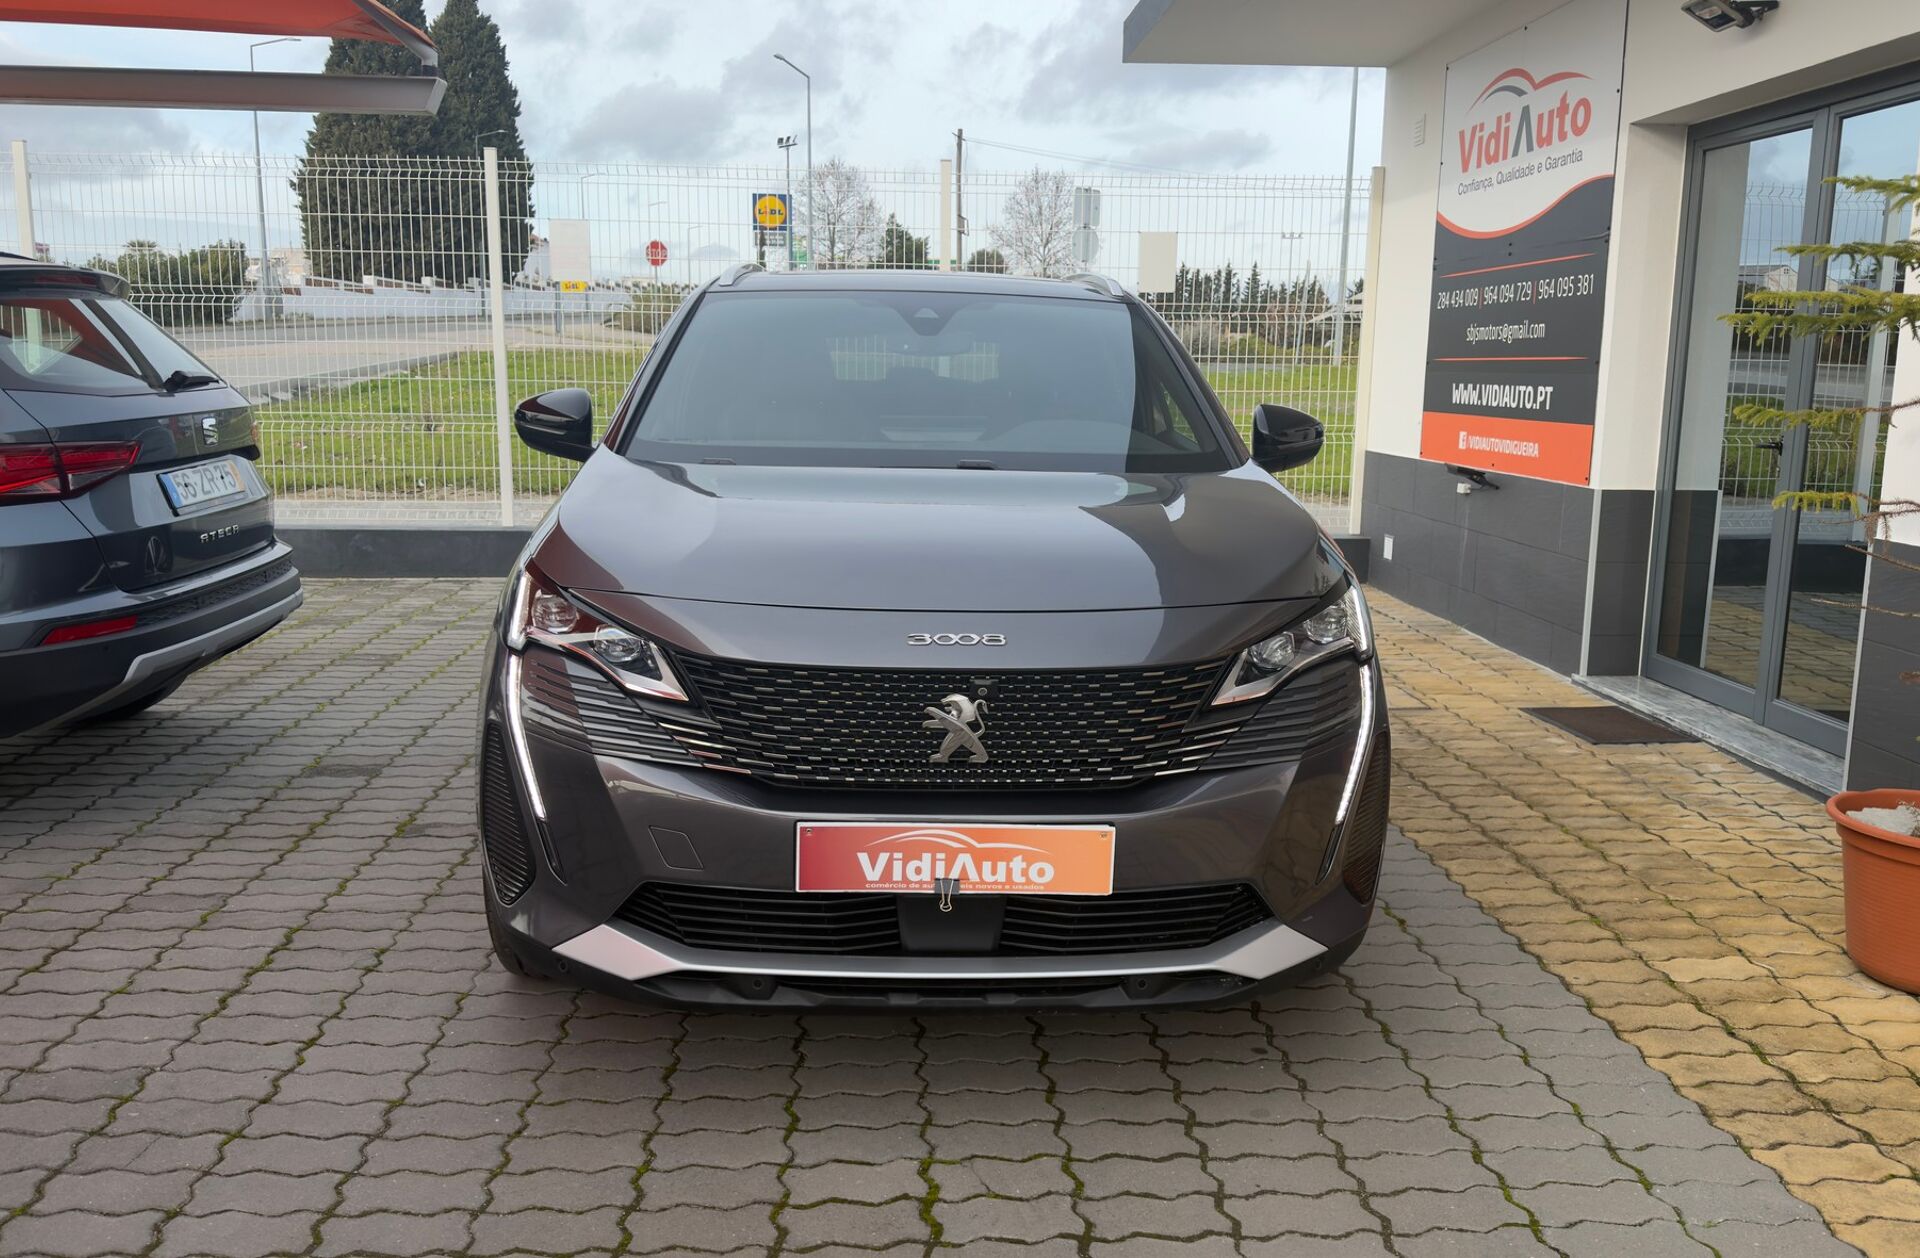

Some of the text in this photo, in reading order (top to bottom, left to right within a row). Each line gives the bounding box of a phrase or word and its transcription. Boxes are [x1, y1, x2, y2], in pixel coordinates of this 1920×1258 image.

[1458, 90, 1592, 174] VidiAuto
[1457, 148, 1583, 196] Confiança, Qualidade e Garantia
[646, 248, 667, 258] STOP
[1437, 273, 1594, 309] 284 434 009 964 094 729 964 095 381
[1452, 383, 1554, 411] WWW.VIDIAUTO.PT
[200, 524, 240, 543] ATECA
[907, 633, 1007, 646] 3008
[857, 852, 1054, 883] VidiAuto
